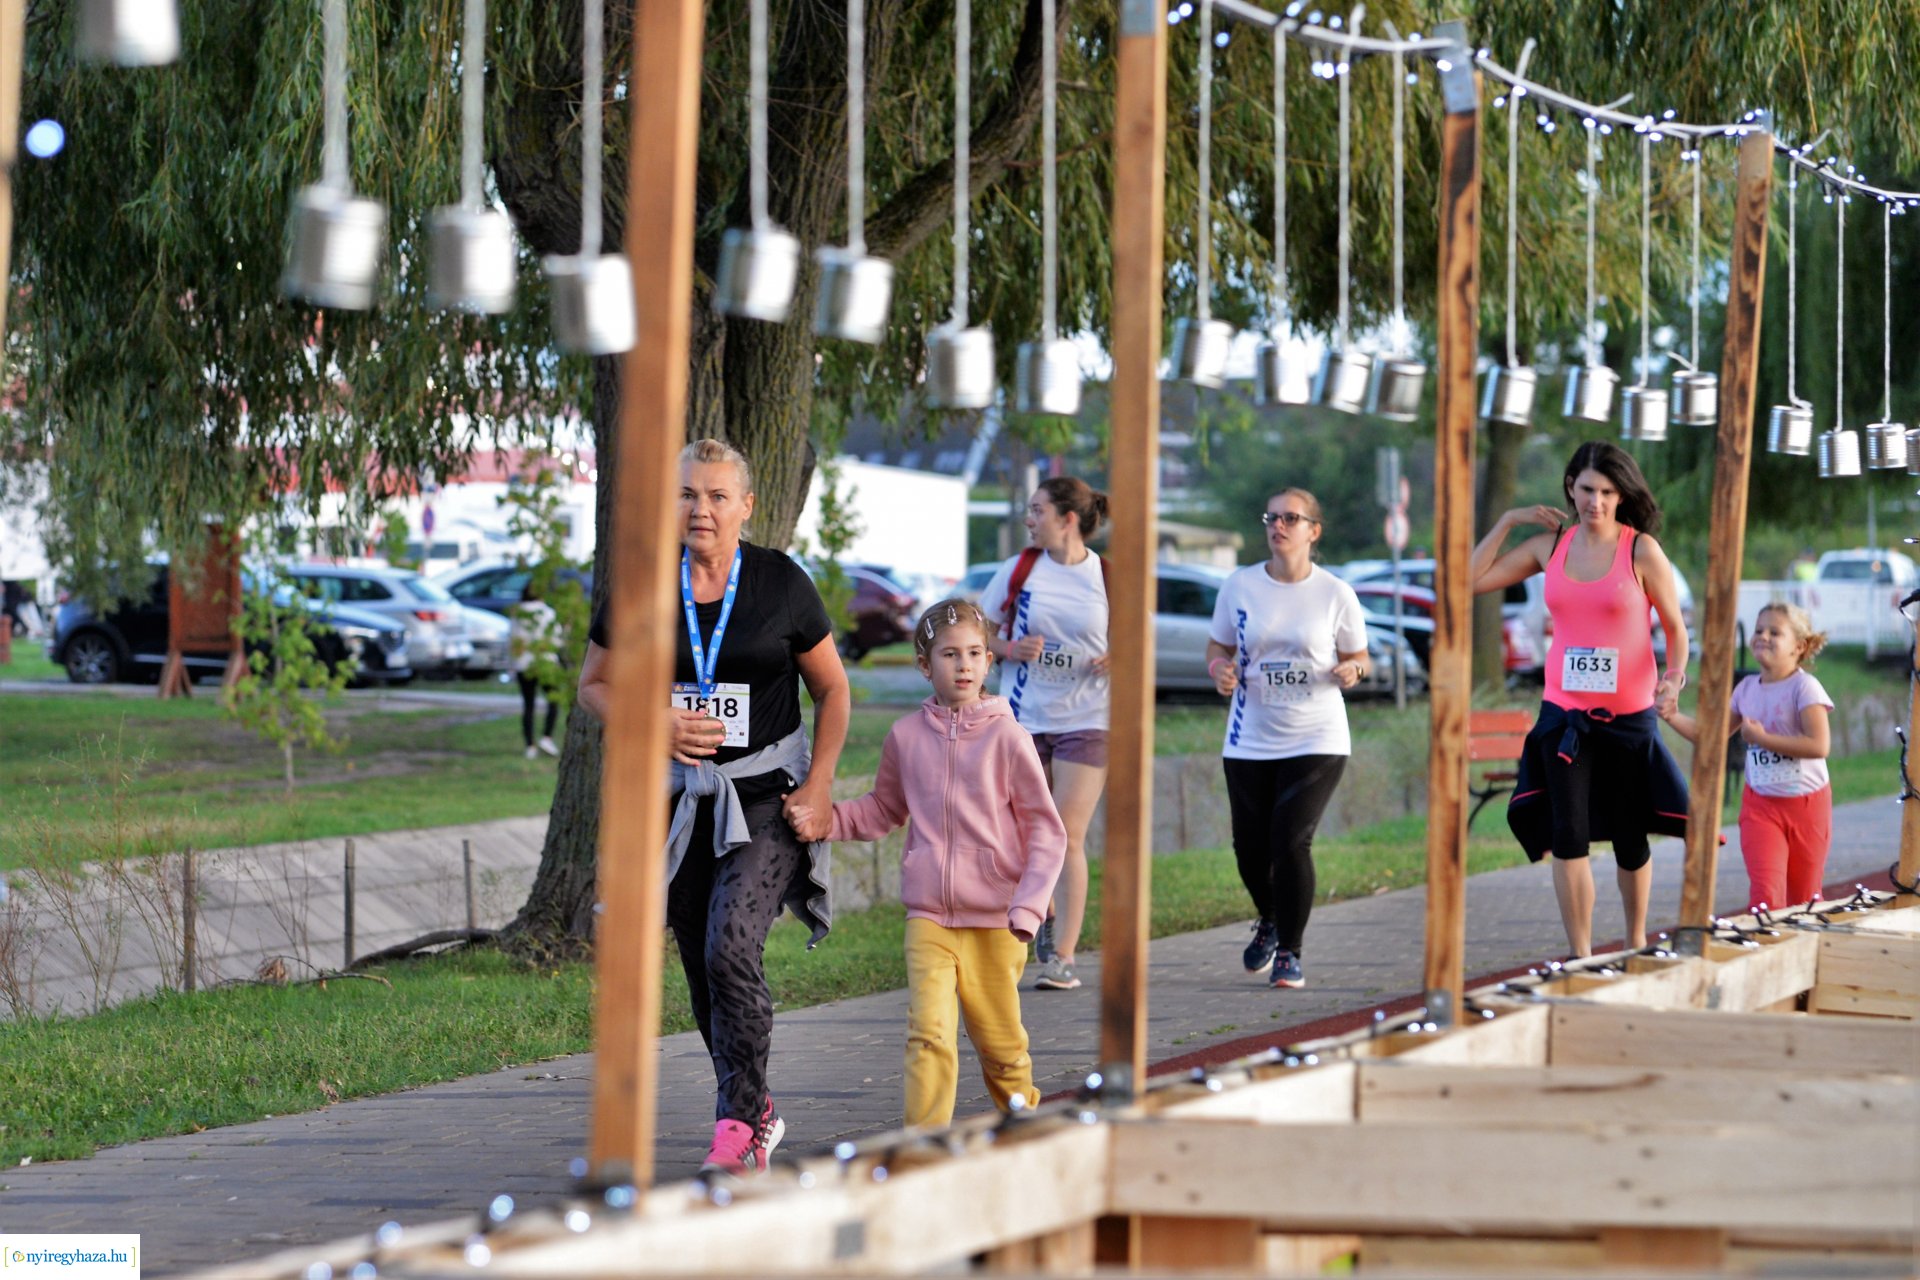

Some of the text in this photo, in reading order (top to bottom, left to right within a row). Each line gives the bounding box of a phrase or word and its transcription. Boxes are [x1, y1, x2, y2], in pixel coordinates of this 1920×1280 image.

[1009, 589, 1032, 722] MICLIN
[1038, 652, 1073, 668] 1561
[1569, 656, 1612, 673] 1633
[1266, 670, 1308, 686] 1562
[683, 696, 738, 718] 1818
